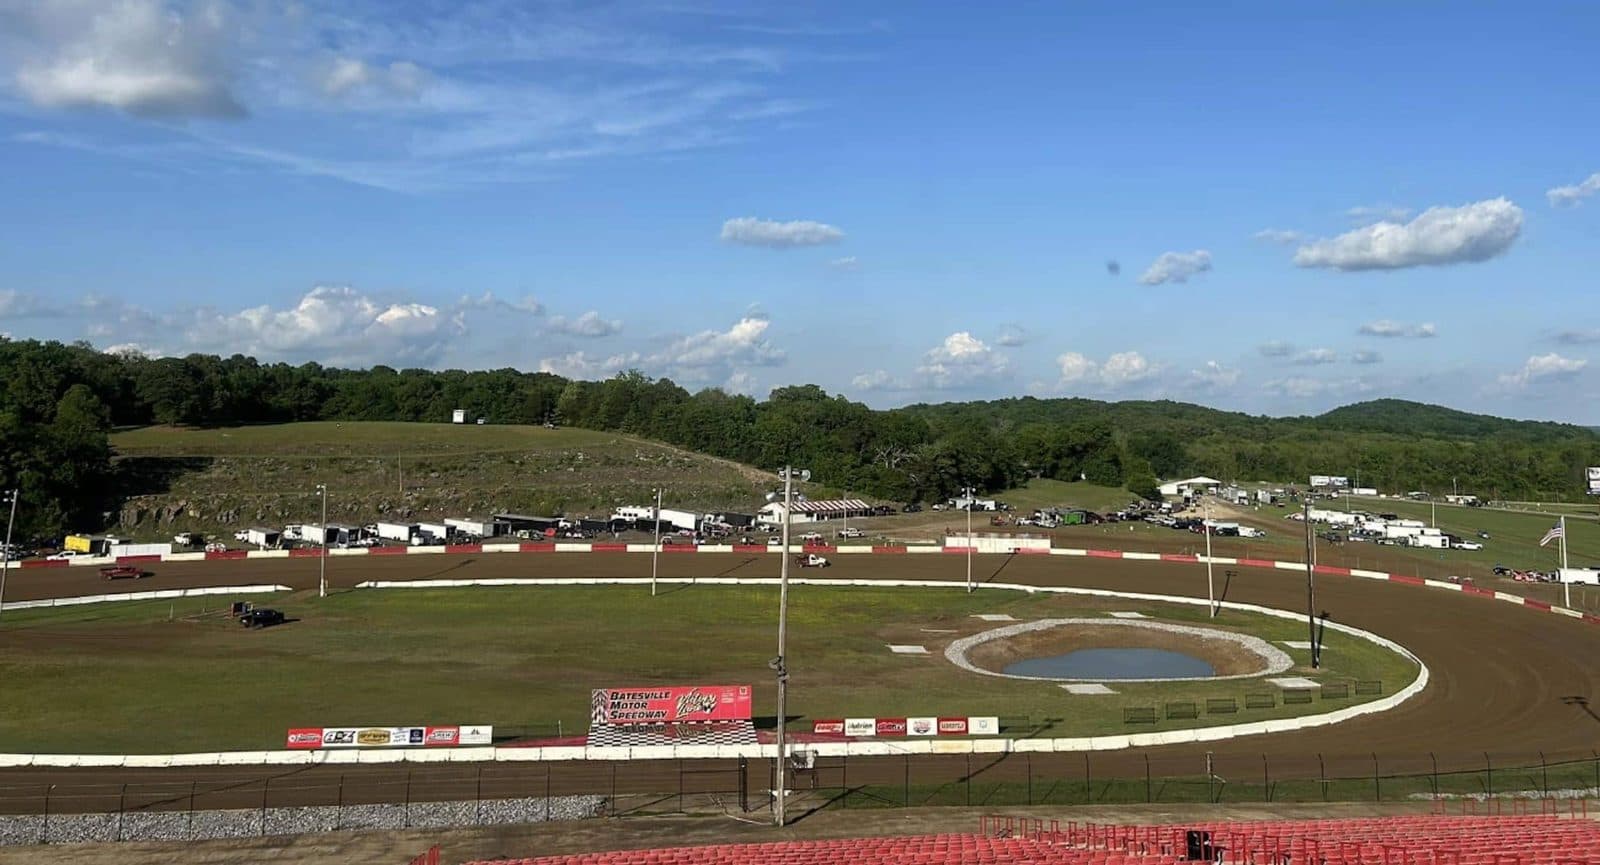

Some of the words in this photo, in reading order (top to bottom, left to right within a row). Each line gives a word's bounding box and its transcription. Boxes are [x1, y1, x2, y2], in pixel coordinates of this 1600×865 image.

[610, 691, 671, 701] BATESVILLE
[610, 701, 648, 710] MOTOR
[610, 710, 667, 720] SPEEDWAY
